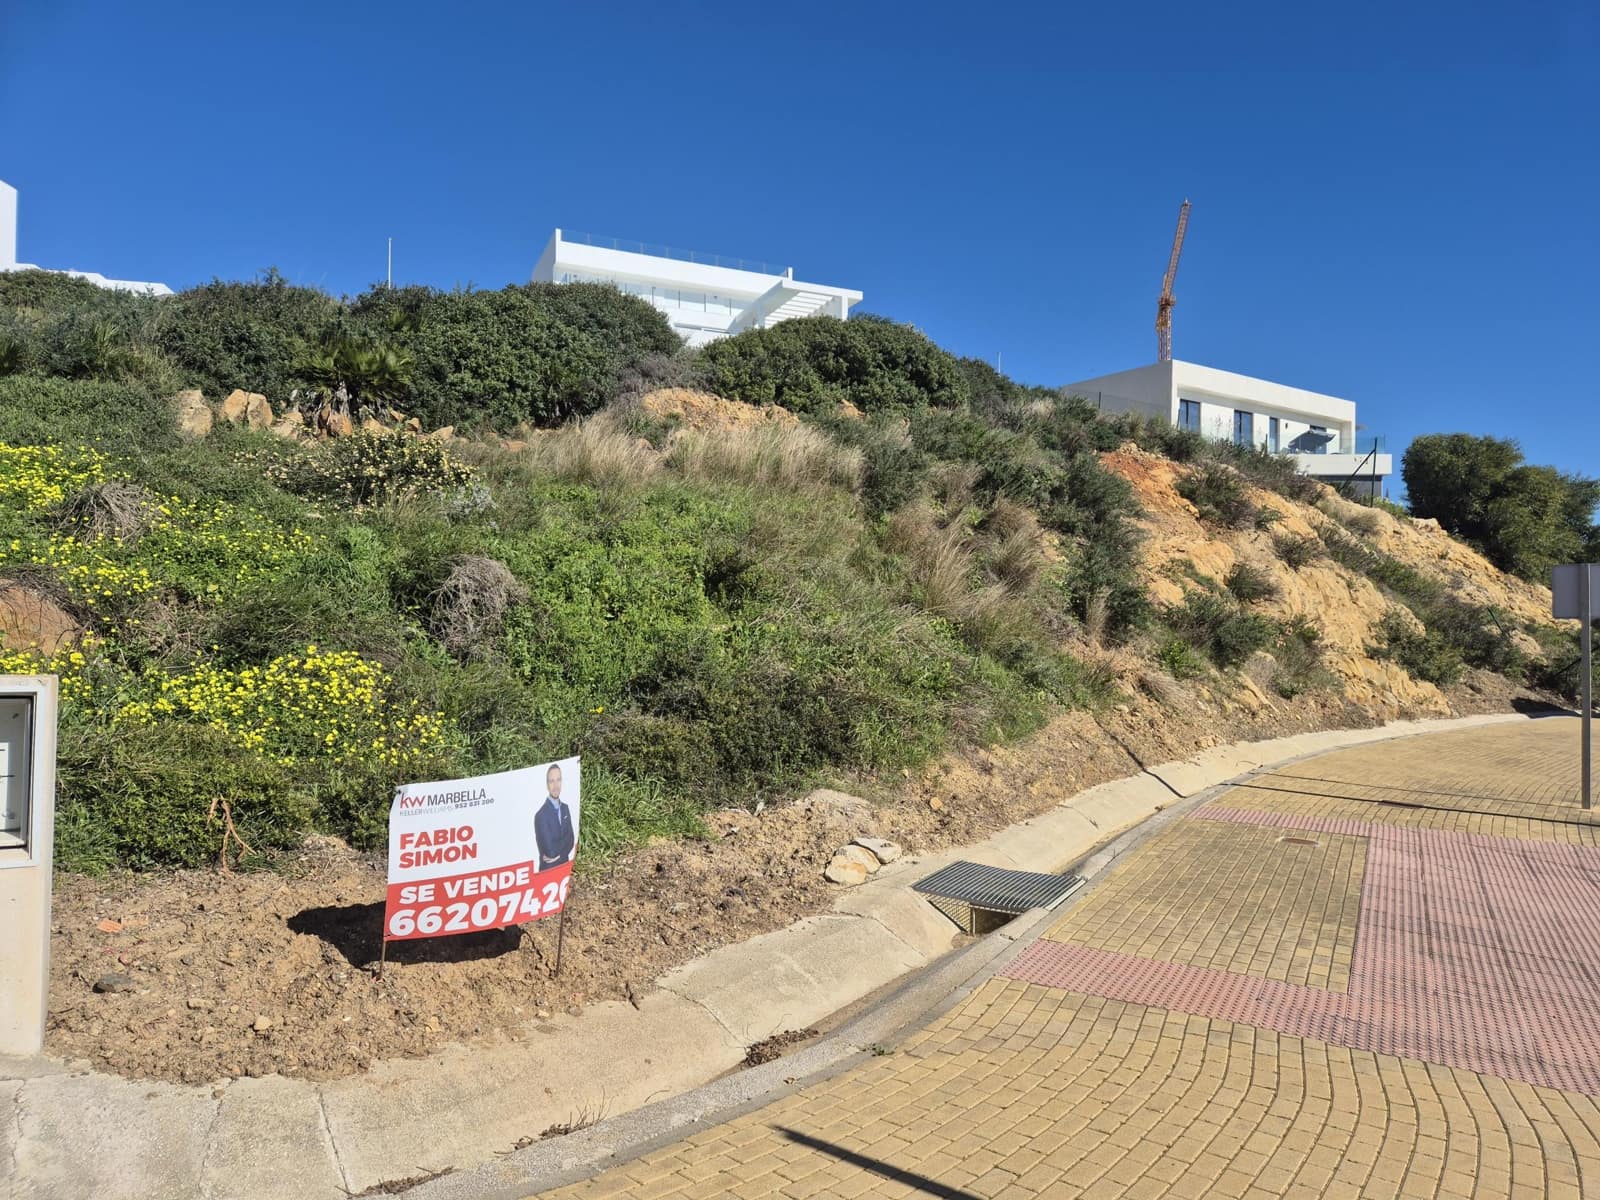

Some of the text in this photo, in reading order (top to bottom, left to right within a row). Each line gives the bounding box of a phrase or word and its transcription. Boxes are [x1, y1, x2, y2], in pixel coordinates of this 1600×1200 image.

[427, 788, 486, 806] MARBELLA
[400, 825, 474, 850] FABIO
[399, 843, 478, 869] SIMON
[399, 867, 530, 904] SE VENDE
